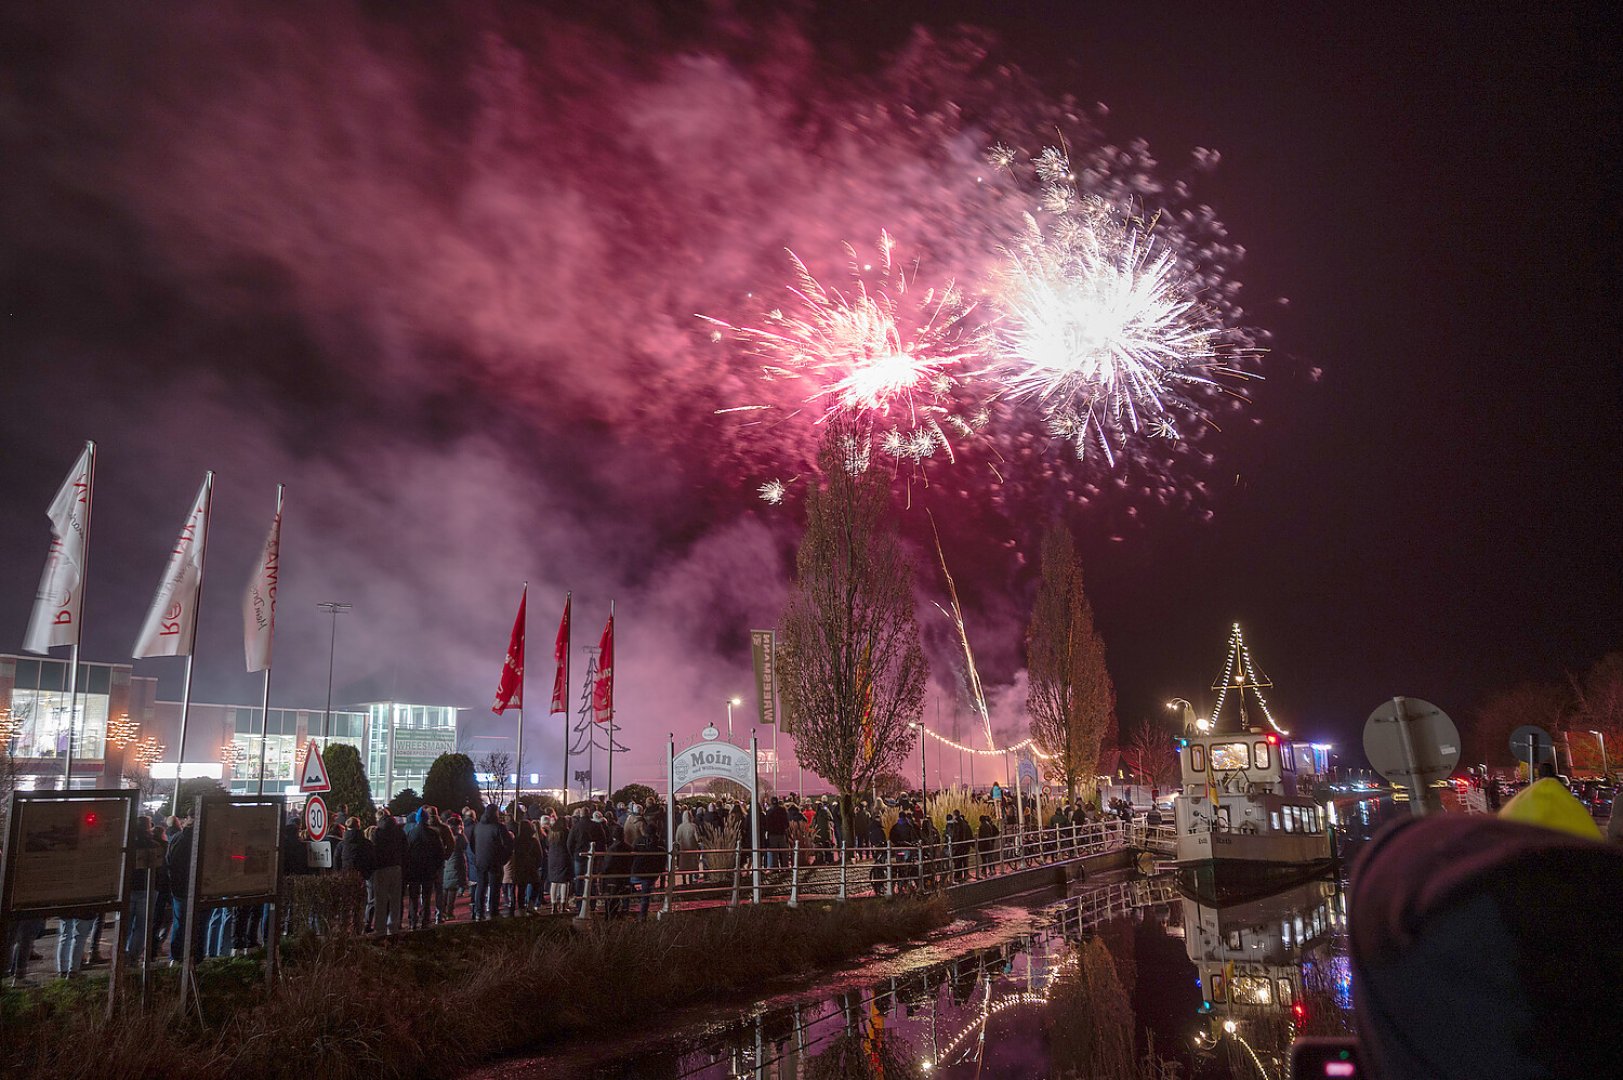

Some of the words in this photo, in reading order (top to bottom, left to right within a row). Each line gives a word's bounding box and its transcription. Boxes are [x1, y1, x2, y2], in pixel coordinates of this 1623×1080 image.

[397, 740, 453, 751] WREESMANN
[690, 751, 732, 767] Moin
[311, 809, 323, 829] 30
